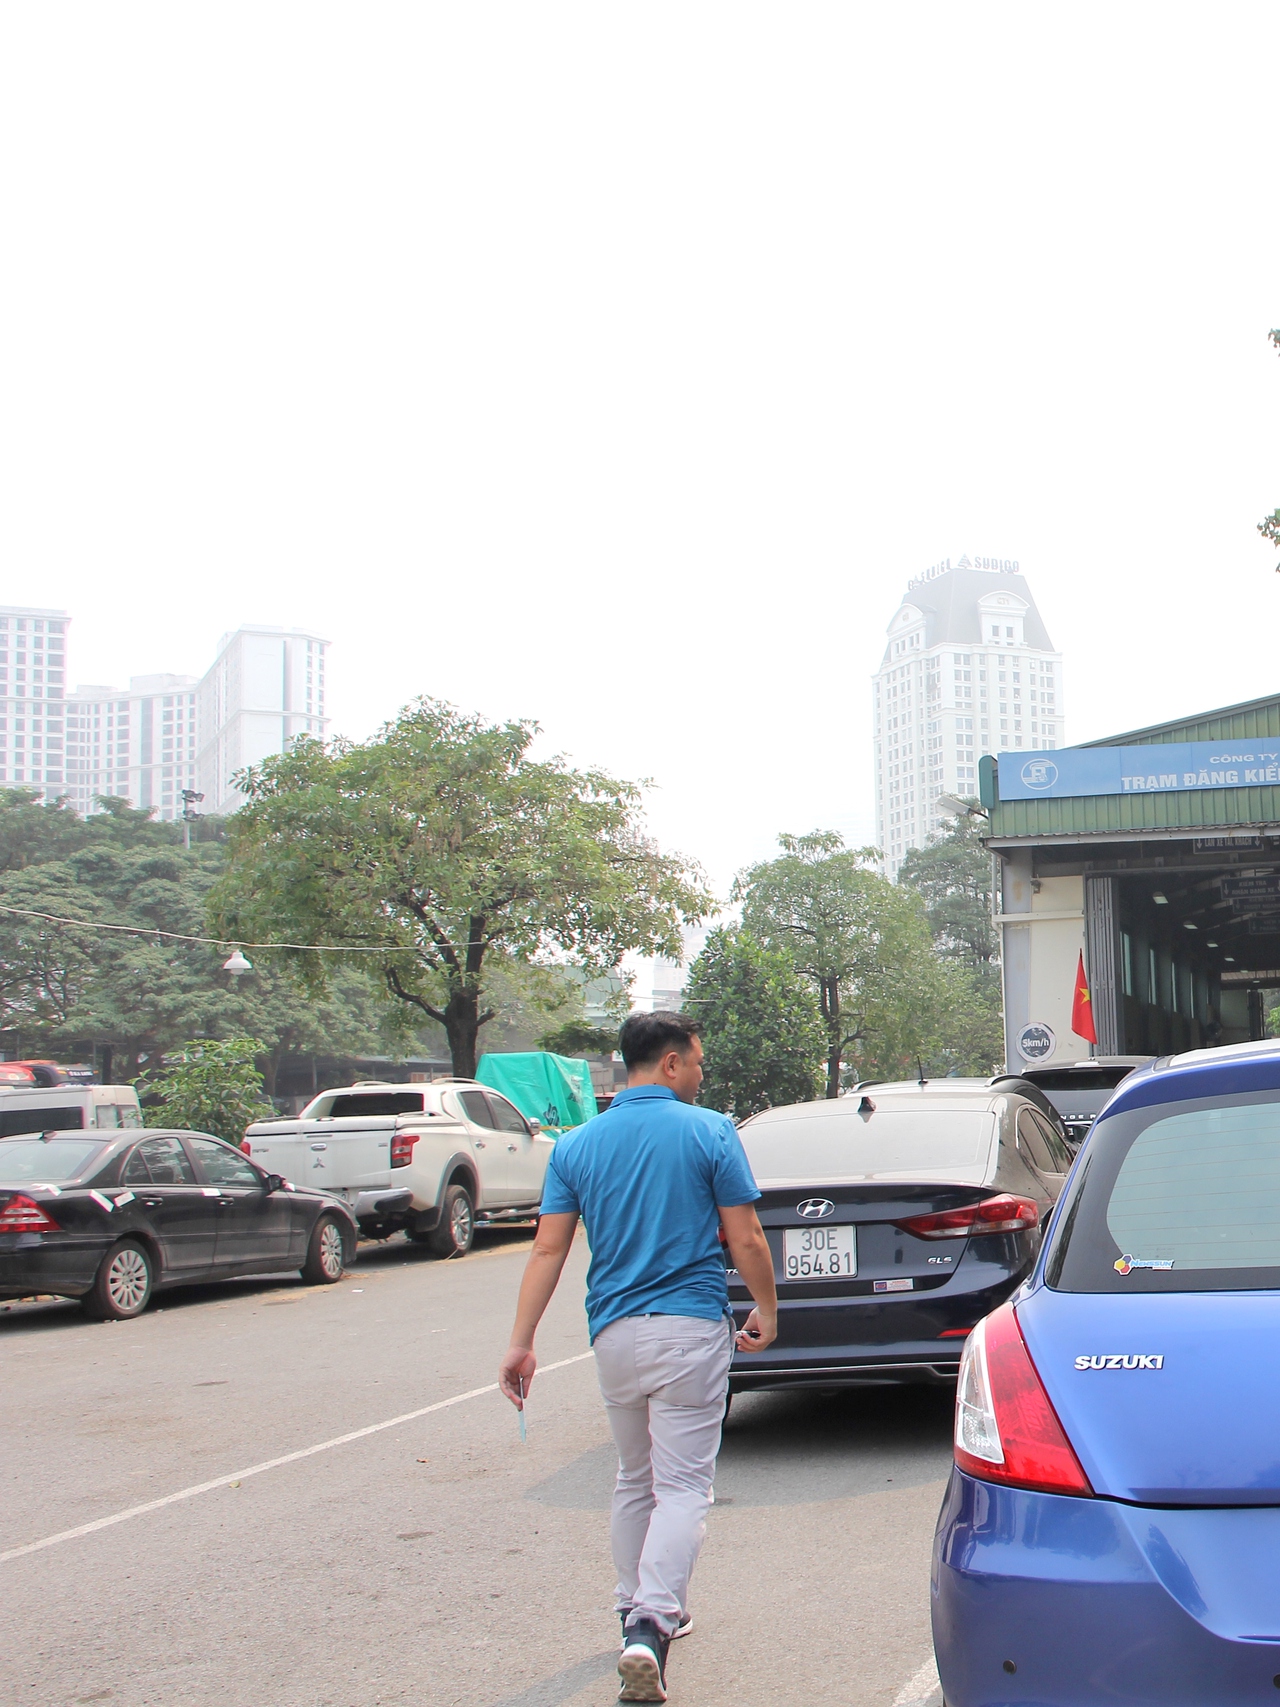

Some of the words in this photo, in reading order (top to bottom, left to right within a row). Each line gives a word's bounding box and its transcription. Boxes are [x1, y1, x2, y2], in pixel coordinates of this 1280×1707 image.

[1209, 753, 1255, 764] CÔNG
[1258, 752, 1278, 761] TY
[1121, 774, 1178, 791] TRẠM
[1183, 769, 1239, 787] ĐĂNG
[1022, 1037, 1050, 1048] 5km/h
[801, 1229, 838, 1251] 30E
[787, 1252, 852, 1276] 954.81
[927, 1256, 952, 1264] GLS
[1074, 1355, 1164, 1370] SUZUKI
